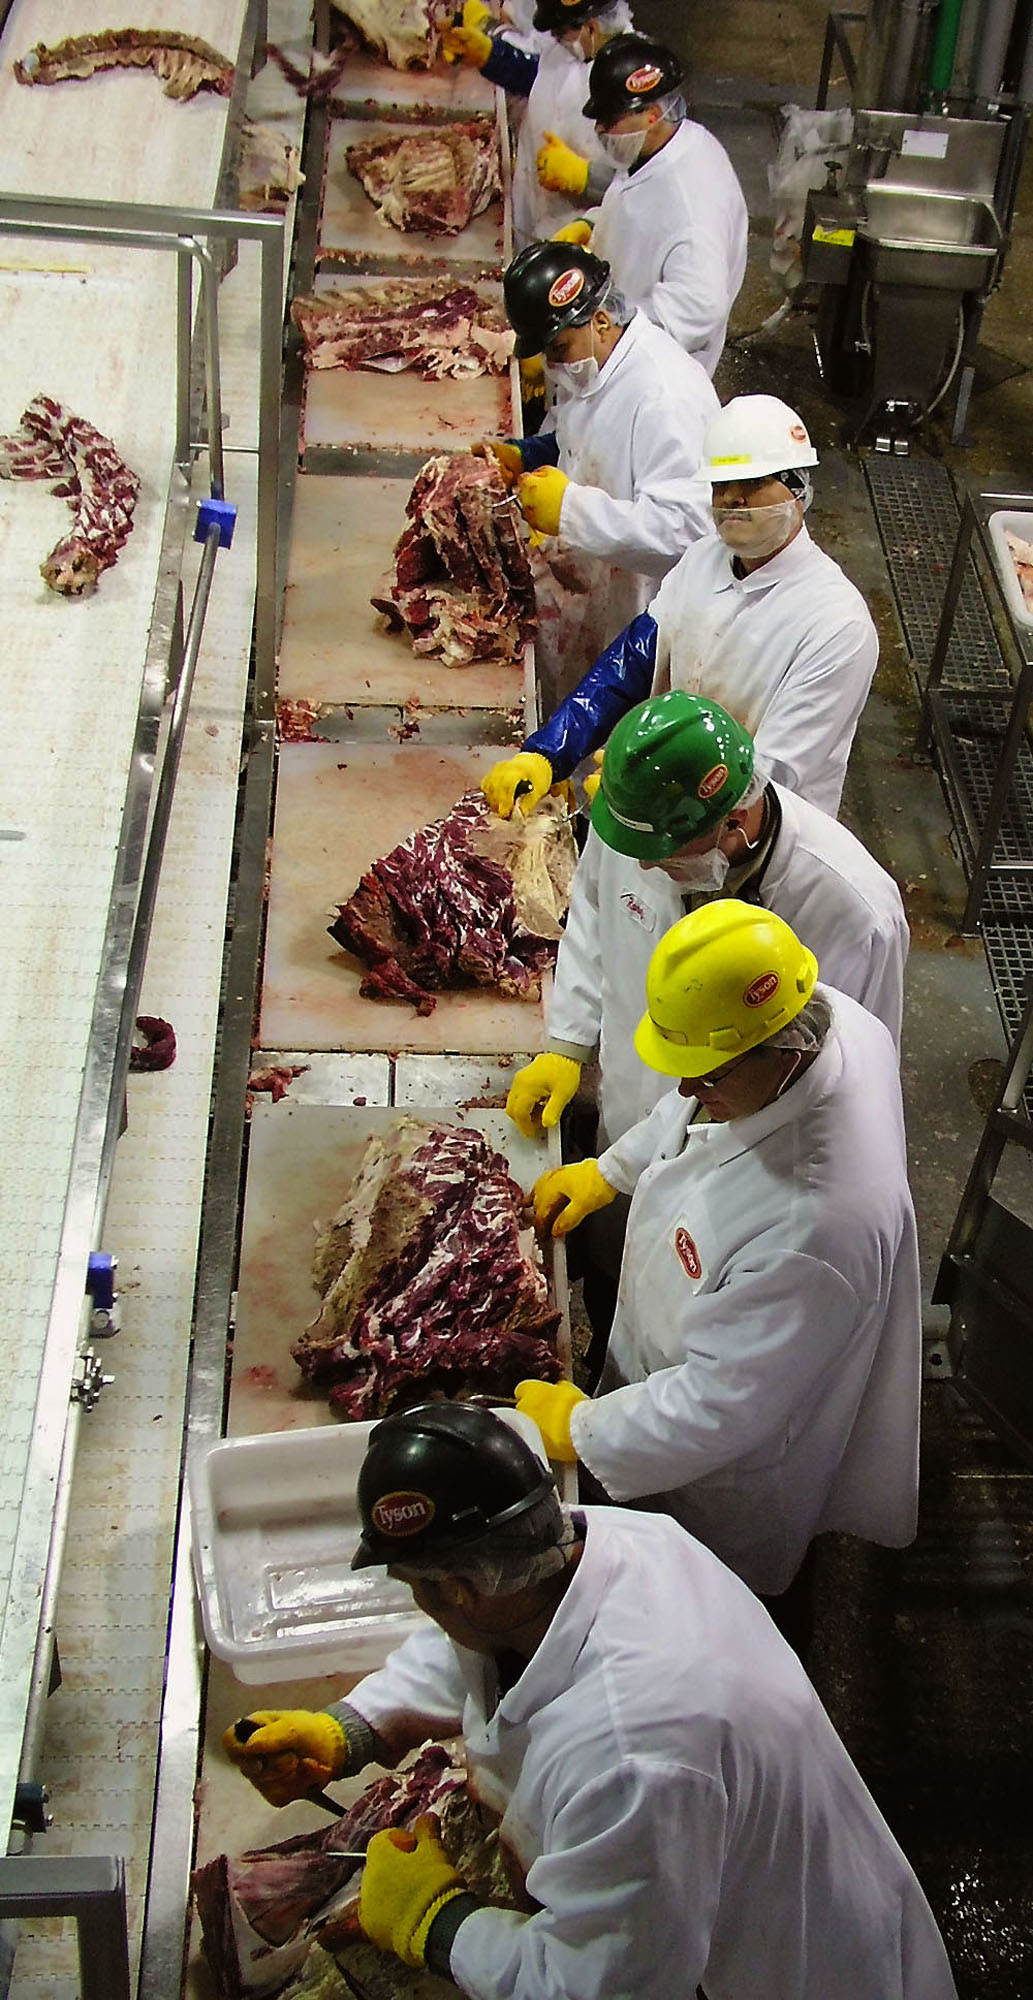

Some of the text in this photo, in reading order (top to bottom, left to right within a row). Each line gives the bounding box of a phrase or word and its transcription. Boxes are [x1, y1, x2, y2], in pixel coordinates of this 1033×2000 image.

[749, 975, 777, 1002] Tyson
[679, 1232, 697, 1273] Tyson
[376, 1502, 426, 1529] Tyson
